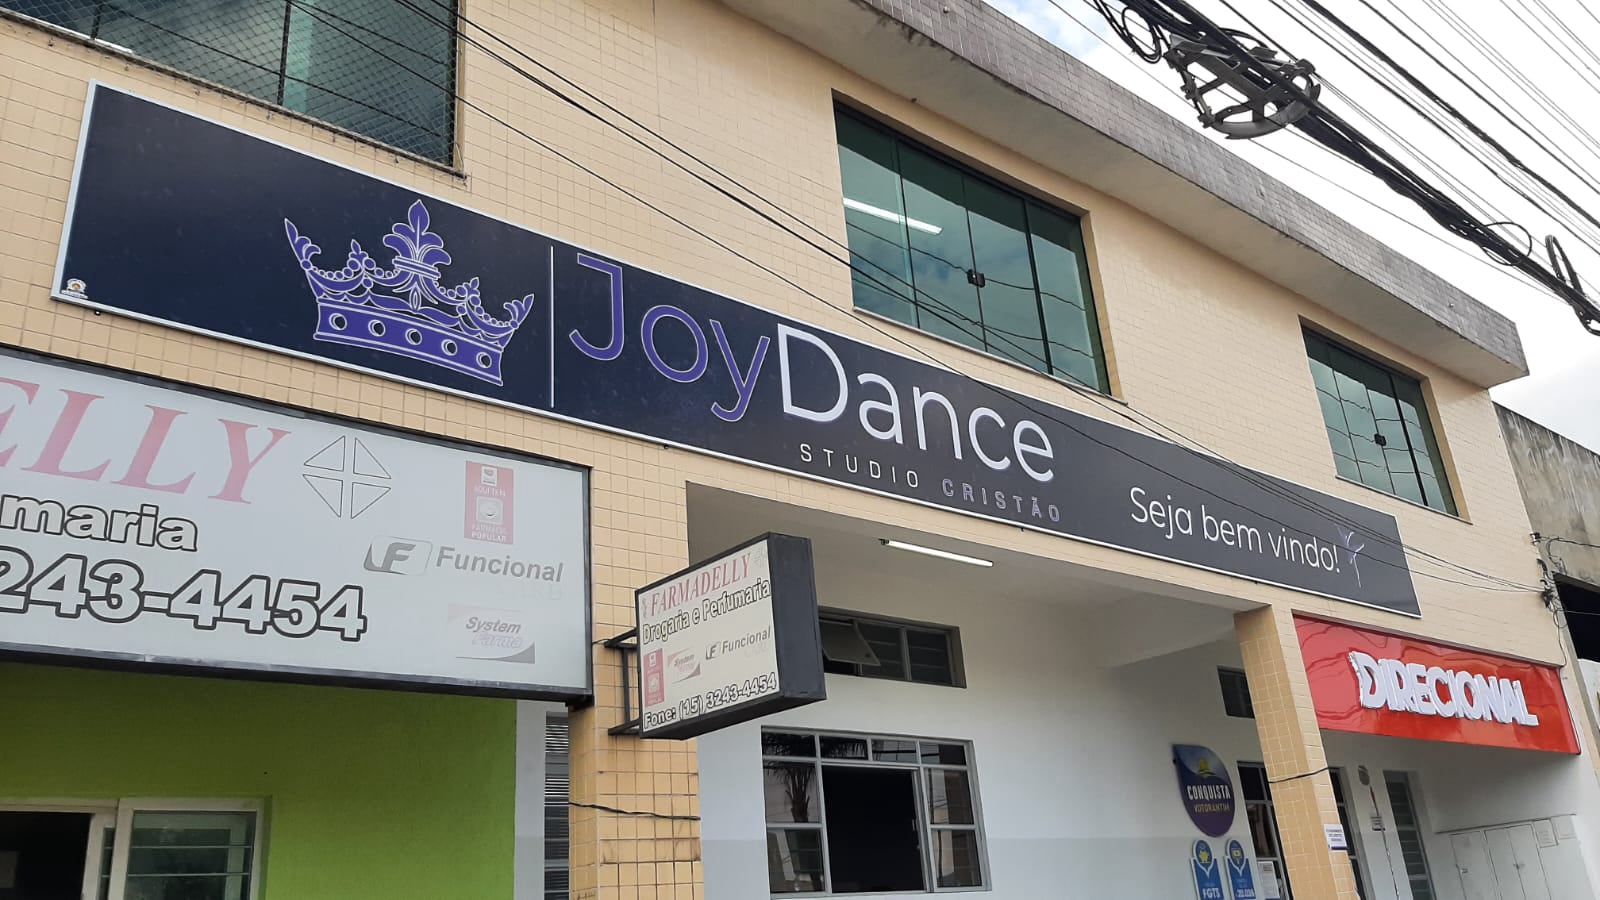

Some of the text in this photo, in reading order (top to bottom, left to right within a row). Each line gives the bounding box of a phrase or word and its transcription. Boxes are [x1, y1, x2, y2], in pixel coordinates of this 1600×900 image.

[800, 443, 1060, 522] STUDIO CRISTÃO
[0, 494, 198, 552] maria
[1130, 486, 1340, 573] Seja bem vindo!
[436, 546, 563, 582] Funcional
[651, 552, 751, 617] FARMADELLY
[465, 617, 521, 634] System
[643, 577, 771, 645] Drogaria e Perfumaria
[722, 625, 771, 654] Funcional
[643, 671, 777, 732] Fone: (15) 3243-4454
[1349, 651, 1539, 726] DIRECIONAL
[1187, 784, 1231, 801] CONQUISTA
